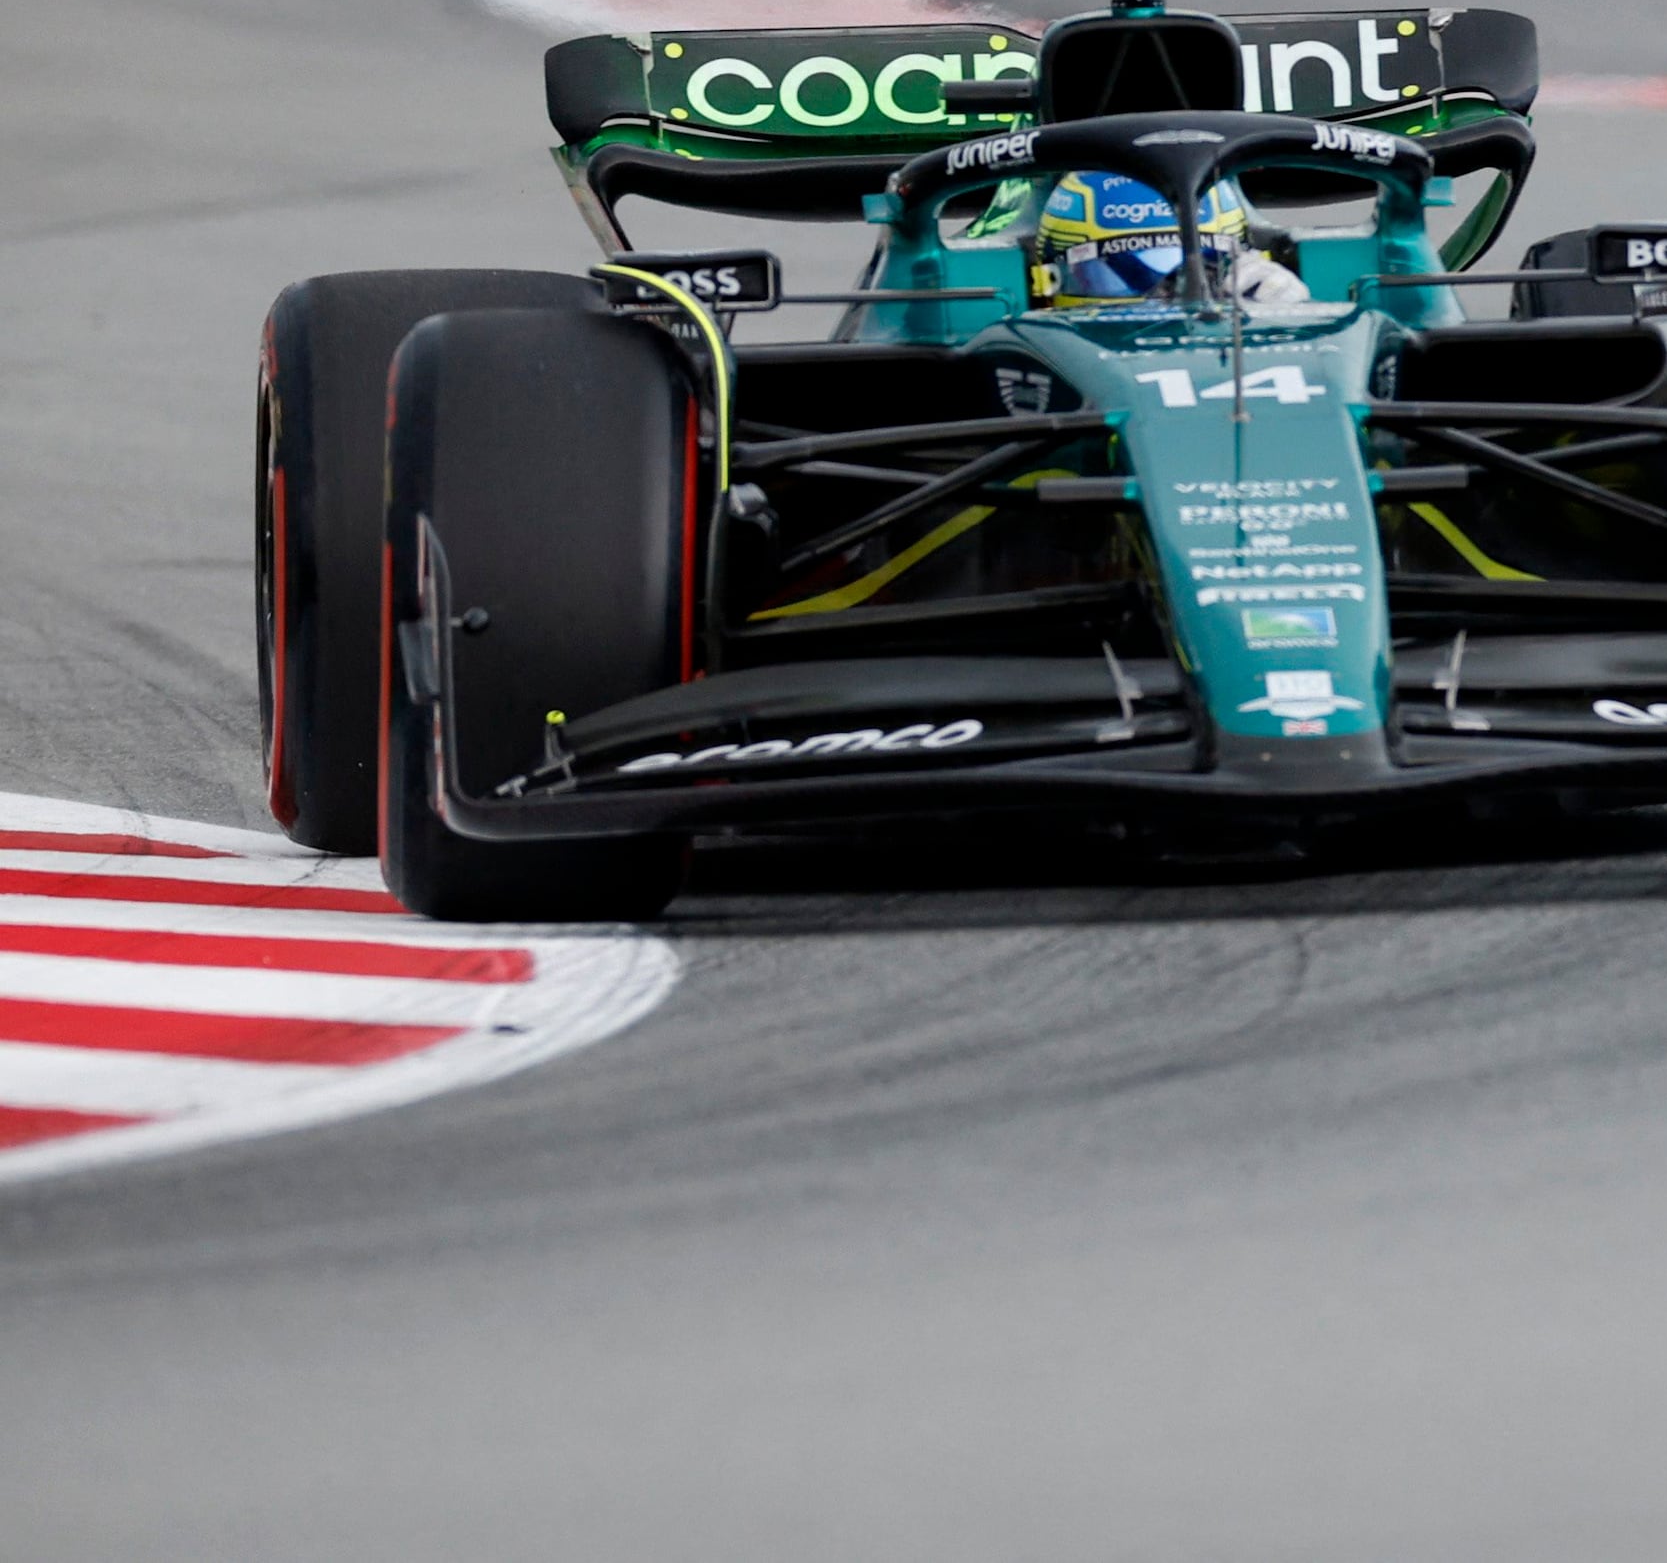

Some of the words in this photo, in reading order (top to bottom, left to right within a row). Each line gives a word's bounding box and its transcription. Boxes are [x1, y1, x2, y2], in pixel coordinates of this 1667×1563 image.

[1101, 235, 1153, 254] ASTON
[1155, 233, 1212, 249] MAN
[636, 267, 741, 299] OSS
[1134, 365, 1327, 408] 14
[1179, 501, 1349, 523] PERONI
[1192, 562, 1363, 580] NetApp
[617, 718, 984, 774] aramco
